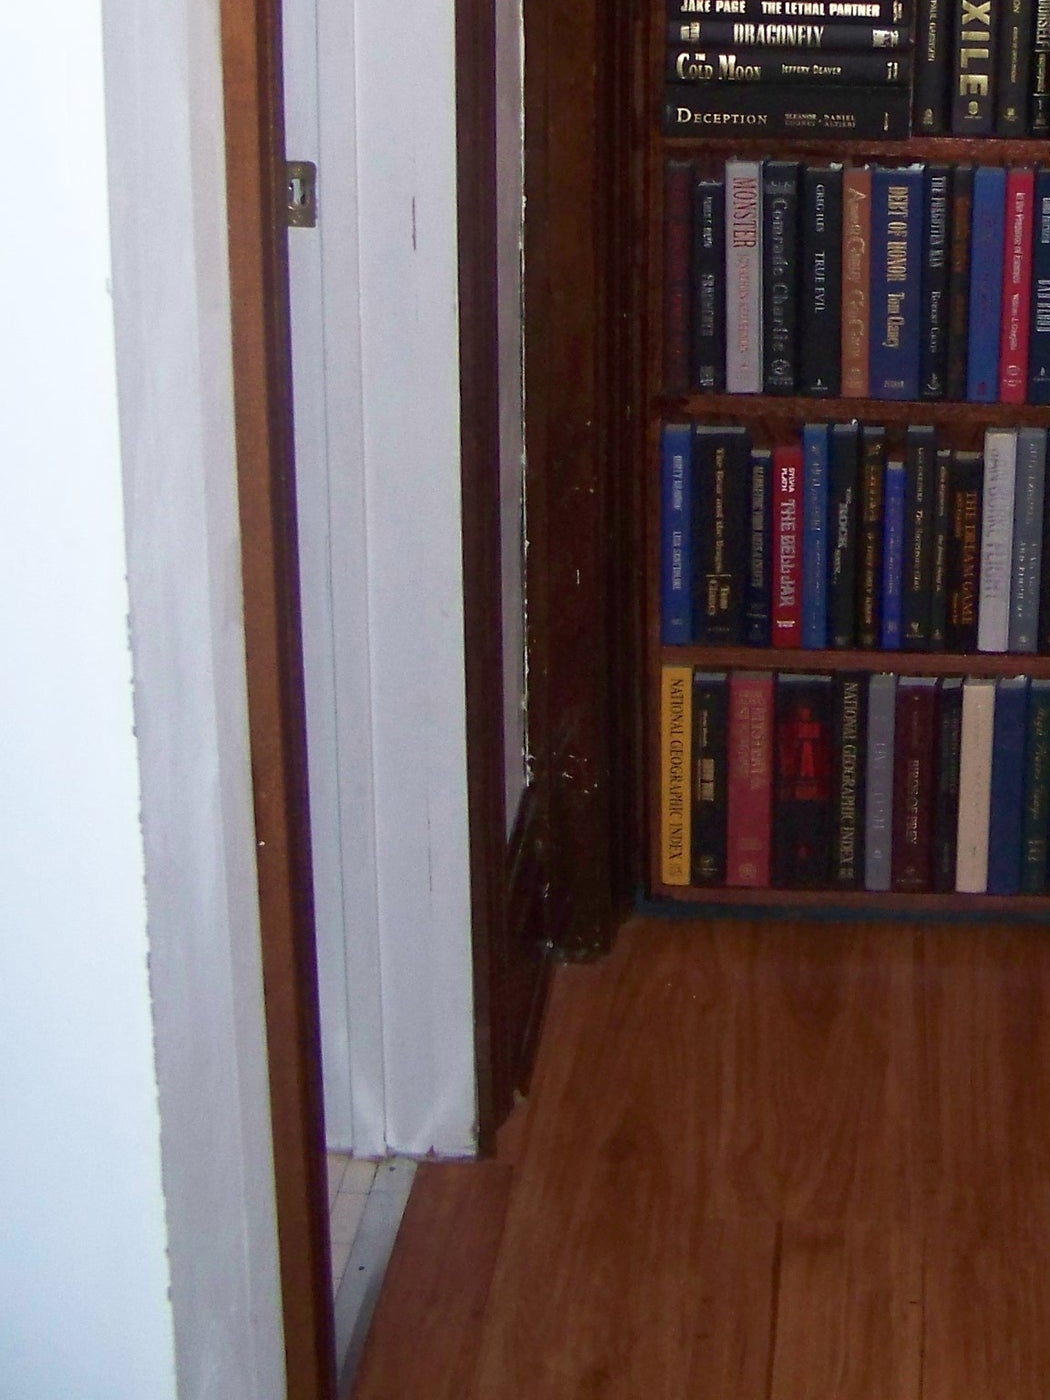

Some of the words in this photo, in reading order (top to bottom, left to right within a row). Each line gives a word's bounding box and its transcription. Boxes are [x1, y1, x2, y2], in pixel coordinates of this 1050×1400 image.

[715, 0, 747, 14] PAGE
[761, 1, 783, 15] THE
[784, 1, 826, 16] LETHAL
[828, 2, 882, 17] PARTNER
[732, 22, 826, 46] DRAGONFLY
[676, 53, 714, 80] COLD
[717, 54, 762, 80] MOON
[675, 107, 768, 125] DECEPTION
[732, 177, 757, 249] MONSTER
[815, 183, 826, 210] GREG
[887, 186, 909, 219] DEBT
[770, 197, 790, 277] Comrade
[886, 221, 908, 238] OF
[813, 251, 827, 284] TRUE
[885, 240, 908, 283] HONOR
[813, 286, 826, 314] EVIL
[886, 291, 906, 314] Tom
[769, 282, 789, 355] Charlie
[881, 315, 906, 350] Clancy
[779, 466, 789, 492] PLATH
[788, 466, 798, 494] SYLVIA
[780, 497, 797, 532] THE
[965, 491, 979, 519] THE
[963, 524, 978, 575] DREAM
[960, 580, 976, 626] GAME
[669, 679, 685, 736] NATIONAL
[841, 681, 859, 739] NATIONAL
[668, 739, 684, 817] GEOGRAPHIC
[839, 743, 857, 824] GEOGRAPHIC
[667, 822, 683, 860] INDEX
[838, 827, 854, 865] INDEX
